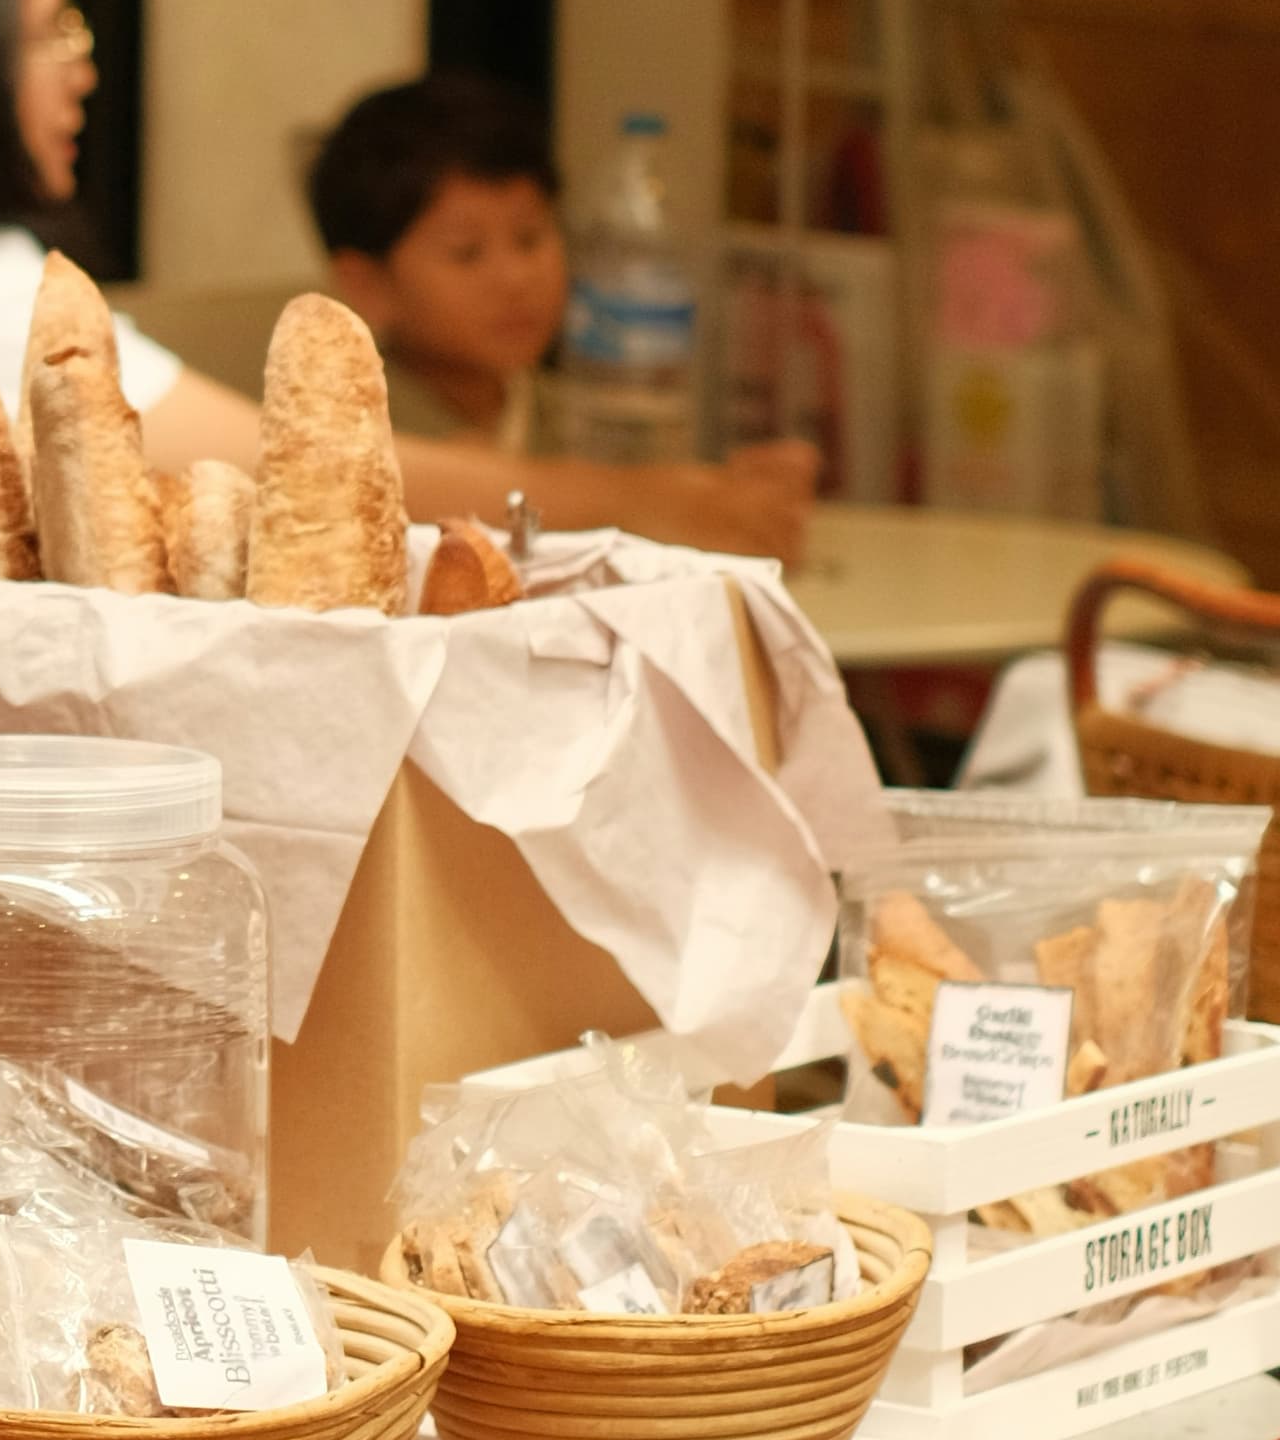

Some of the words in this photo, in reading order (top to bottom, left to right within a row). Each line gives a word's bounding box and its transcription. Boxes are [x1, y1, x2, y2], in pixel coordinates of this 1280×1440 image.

[1110, 1088, 1194, 1147] NATURALLY
[1085, 1217, 1171, 1292] STORAGE
[1177, 1202, 1213, 1263] BOX
[192, 1268, 251, 1384] Blisscotti
